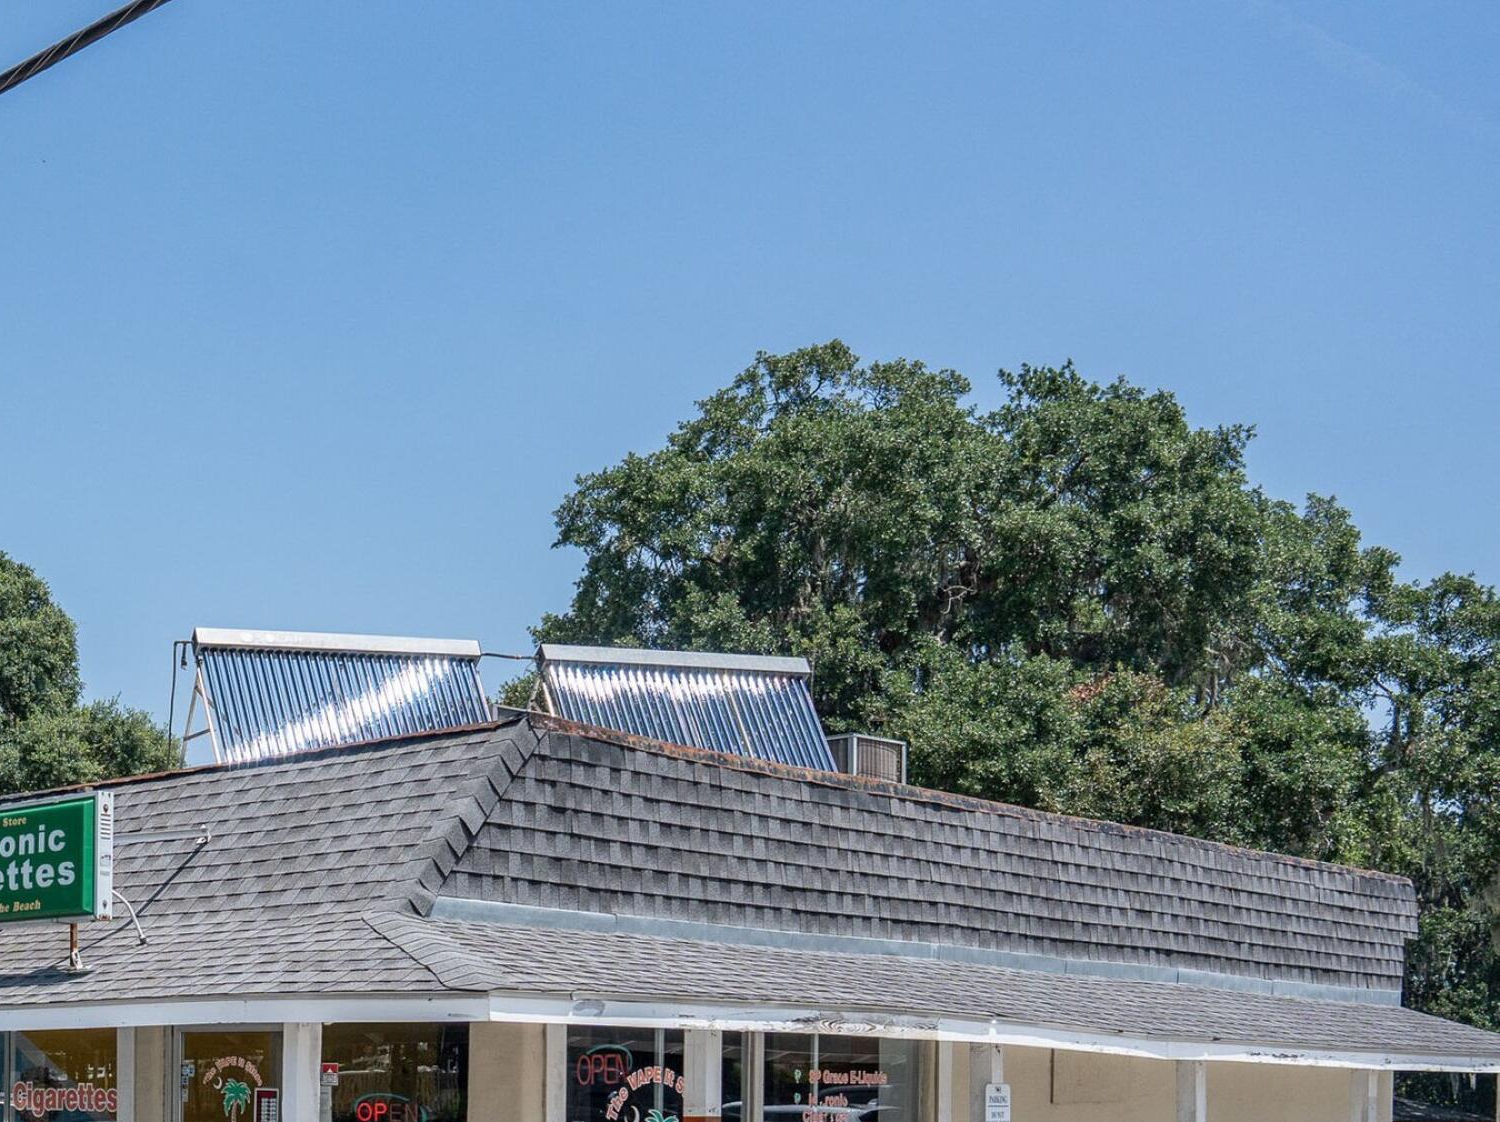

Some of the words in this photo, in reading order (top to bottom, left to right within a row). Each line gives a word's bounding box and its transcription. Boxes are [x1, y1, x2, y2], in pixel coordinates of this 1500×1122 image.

[2, 816, 27, 828] Store
[13, 899, 41, 911] Beach
[575, 1052, 629, 1086] OPEN
[849, 1069, 888, 1088] E-Liquids
[11, 1081, 118, 1118] Cigarettes
[605, 1086, 629, 1121] The
[627, 1066, 662, 1091] VAPE
[664, 1067, 675, 1088] It
